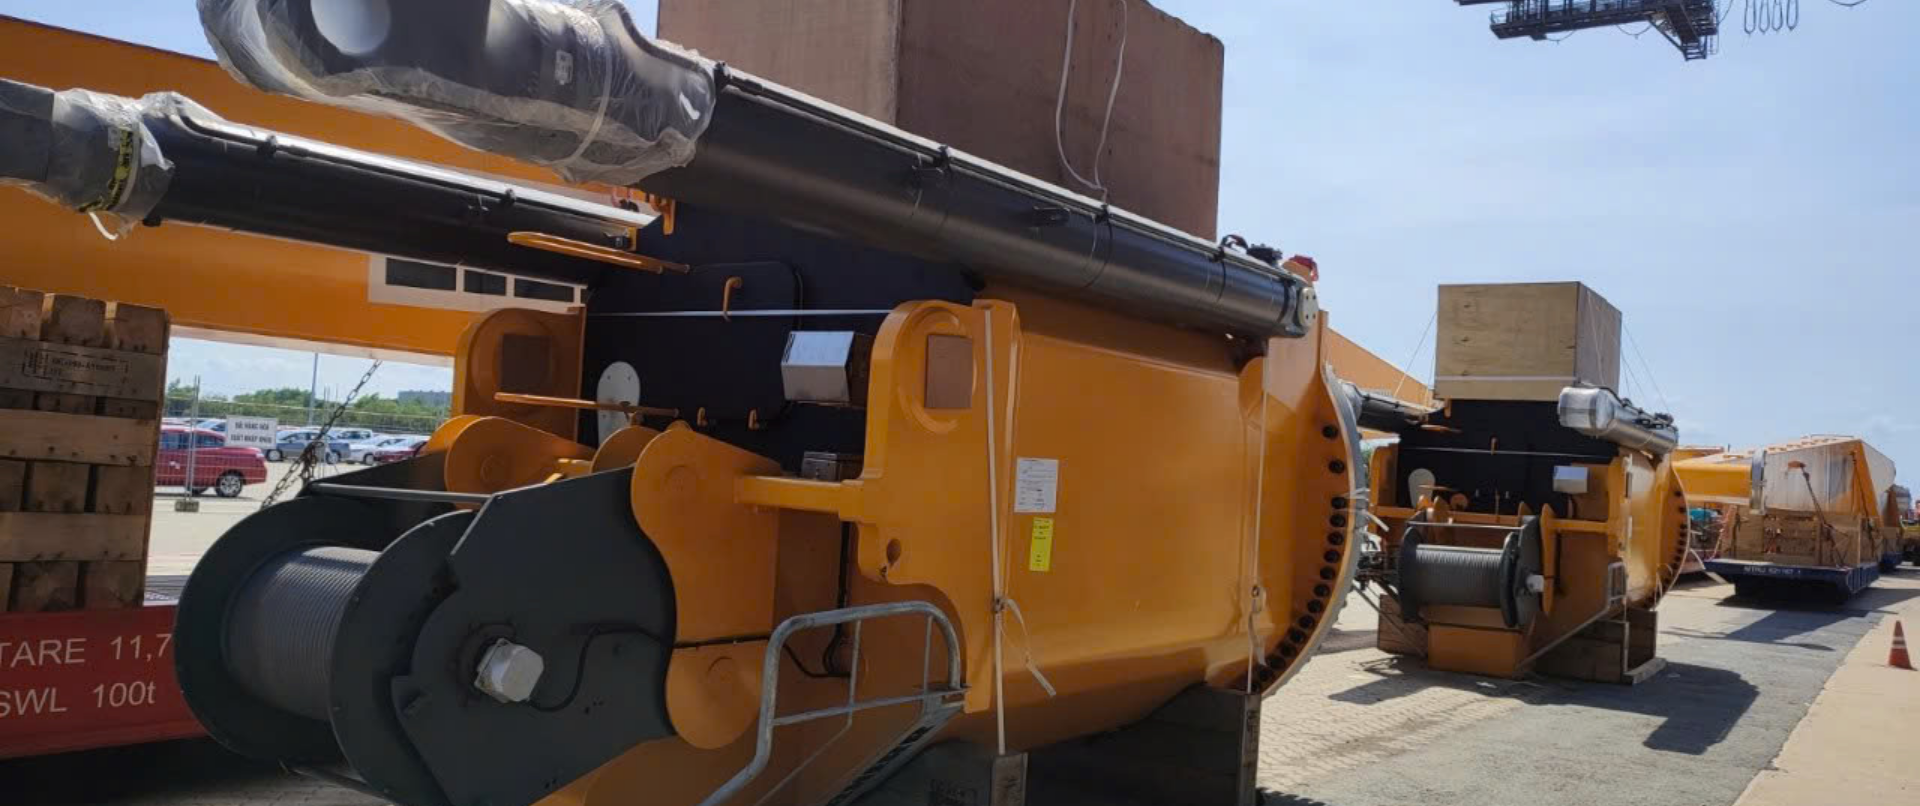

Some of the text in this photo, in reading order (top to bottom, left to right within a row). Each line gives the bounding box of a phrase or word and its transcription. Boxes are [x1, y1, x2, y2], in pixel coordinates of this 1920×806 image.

[110, 633, 173, 661] 11,7
[0, 681, 157, 718] SWL 100t
